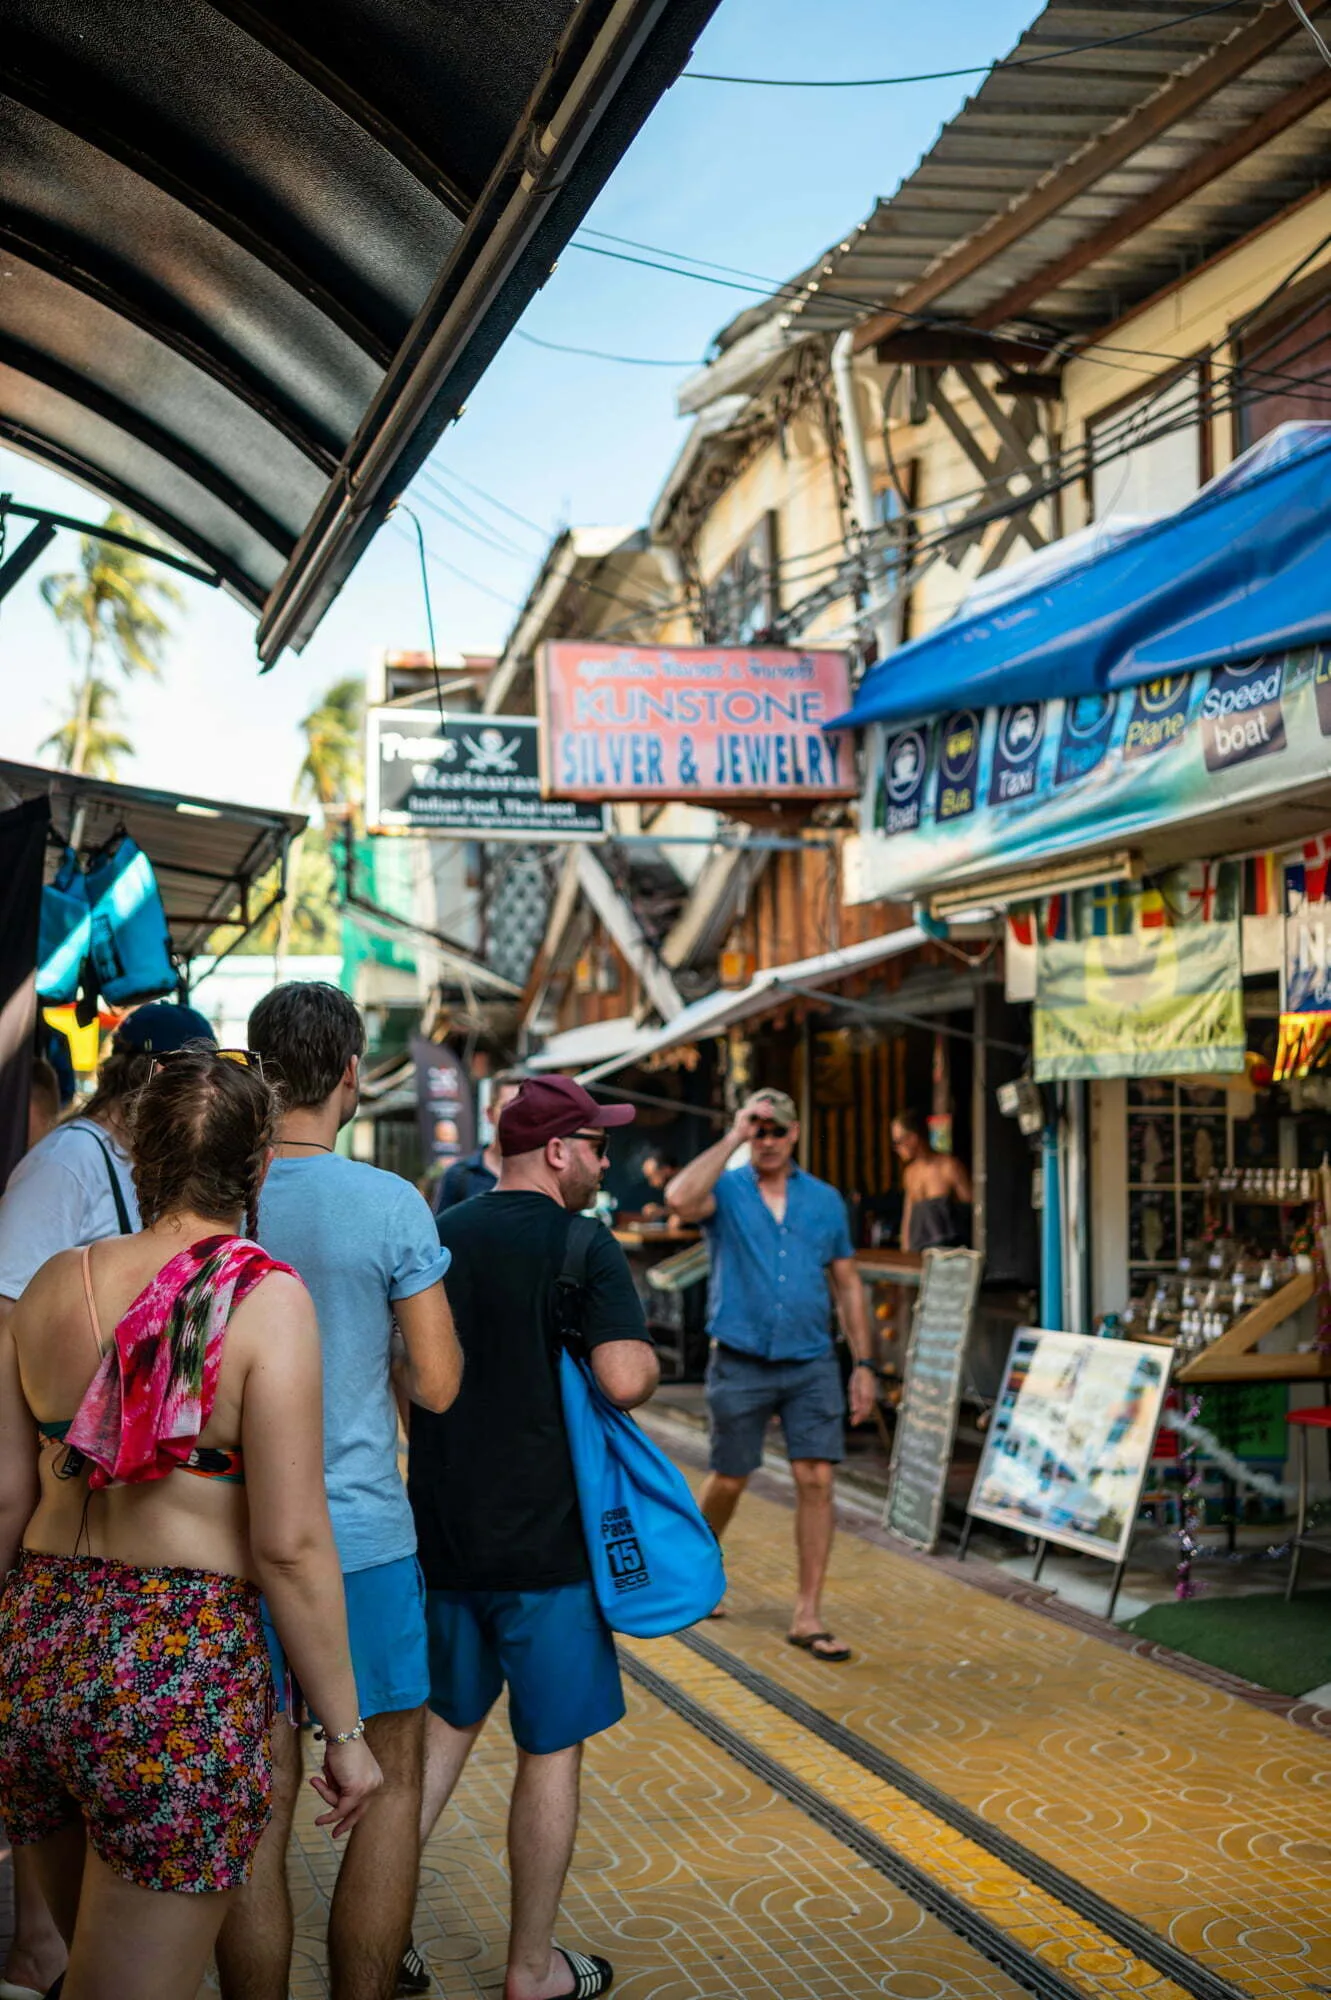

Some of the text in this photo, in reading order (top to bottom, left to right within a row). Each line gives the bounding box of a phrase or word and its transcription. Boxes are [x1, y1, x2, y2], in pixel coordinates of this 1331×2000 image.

[575, 687, 824, 725] KUNSTONE
[1202, 666, 1281, 722] Speed
[1125, 712, 1185, 751] Plane
[1214, 713, 1270, 757] boat
[562, 732, 842, 785] SILVER & JEWELRY
[411, 764, 540, 793] Restauran
[998, 762, 1034, 799] Taxi
[608, 1541, 641, 1573] 15
